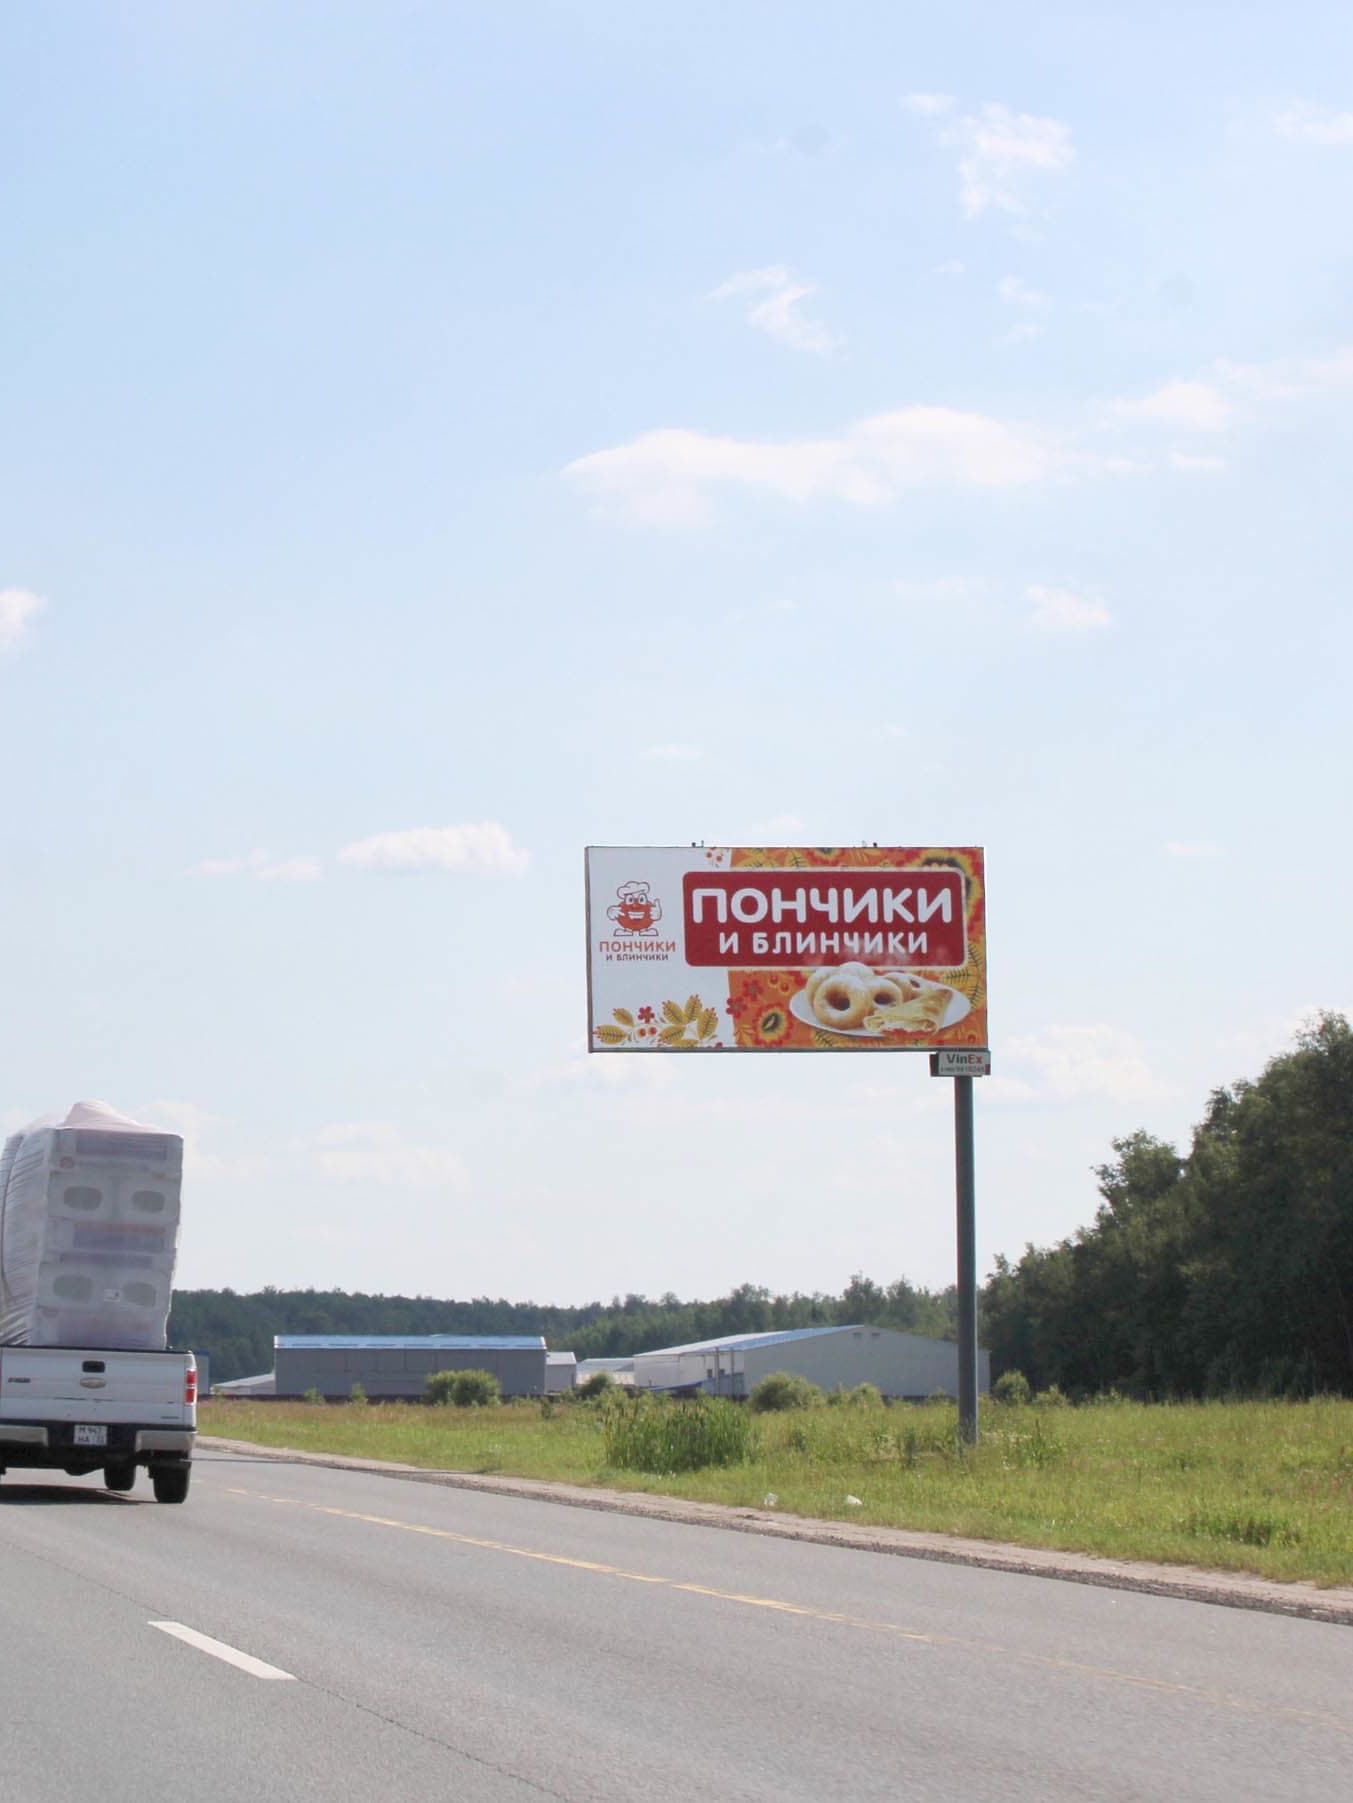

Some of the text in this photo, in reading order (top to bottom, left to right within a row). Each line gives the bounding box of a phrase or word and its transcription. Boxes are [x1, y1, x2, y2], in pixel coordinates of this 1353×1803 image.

[692, 887, 952, 924] ПОНЧИКИ
[599, 941, 676, 953] ПОНЧИКИ
[719, 931, 928, 955] И БЛИНЧИКИ
[606, 953, 669, 961] И БЛИНЧИКИ
[946, 1053, 983, 1065] VinEx
